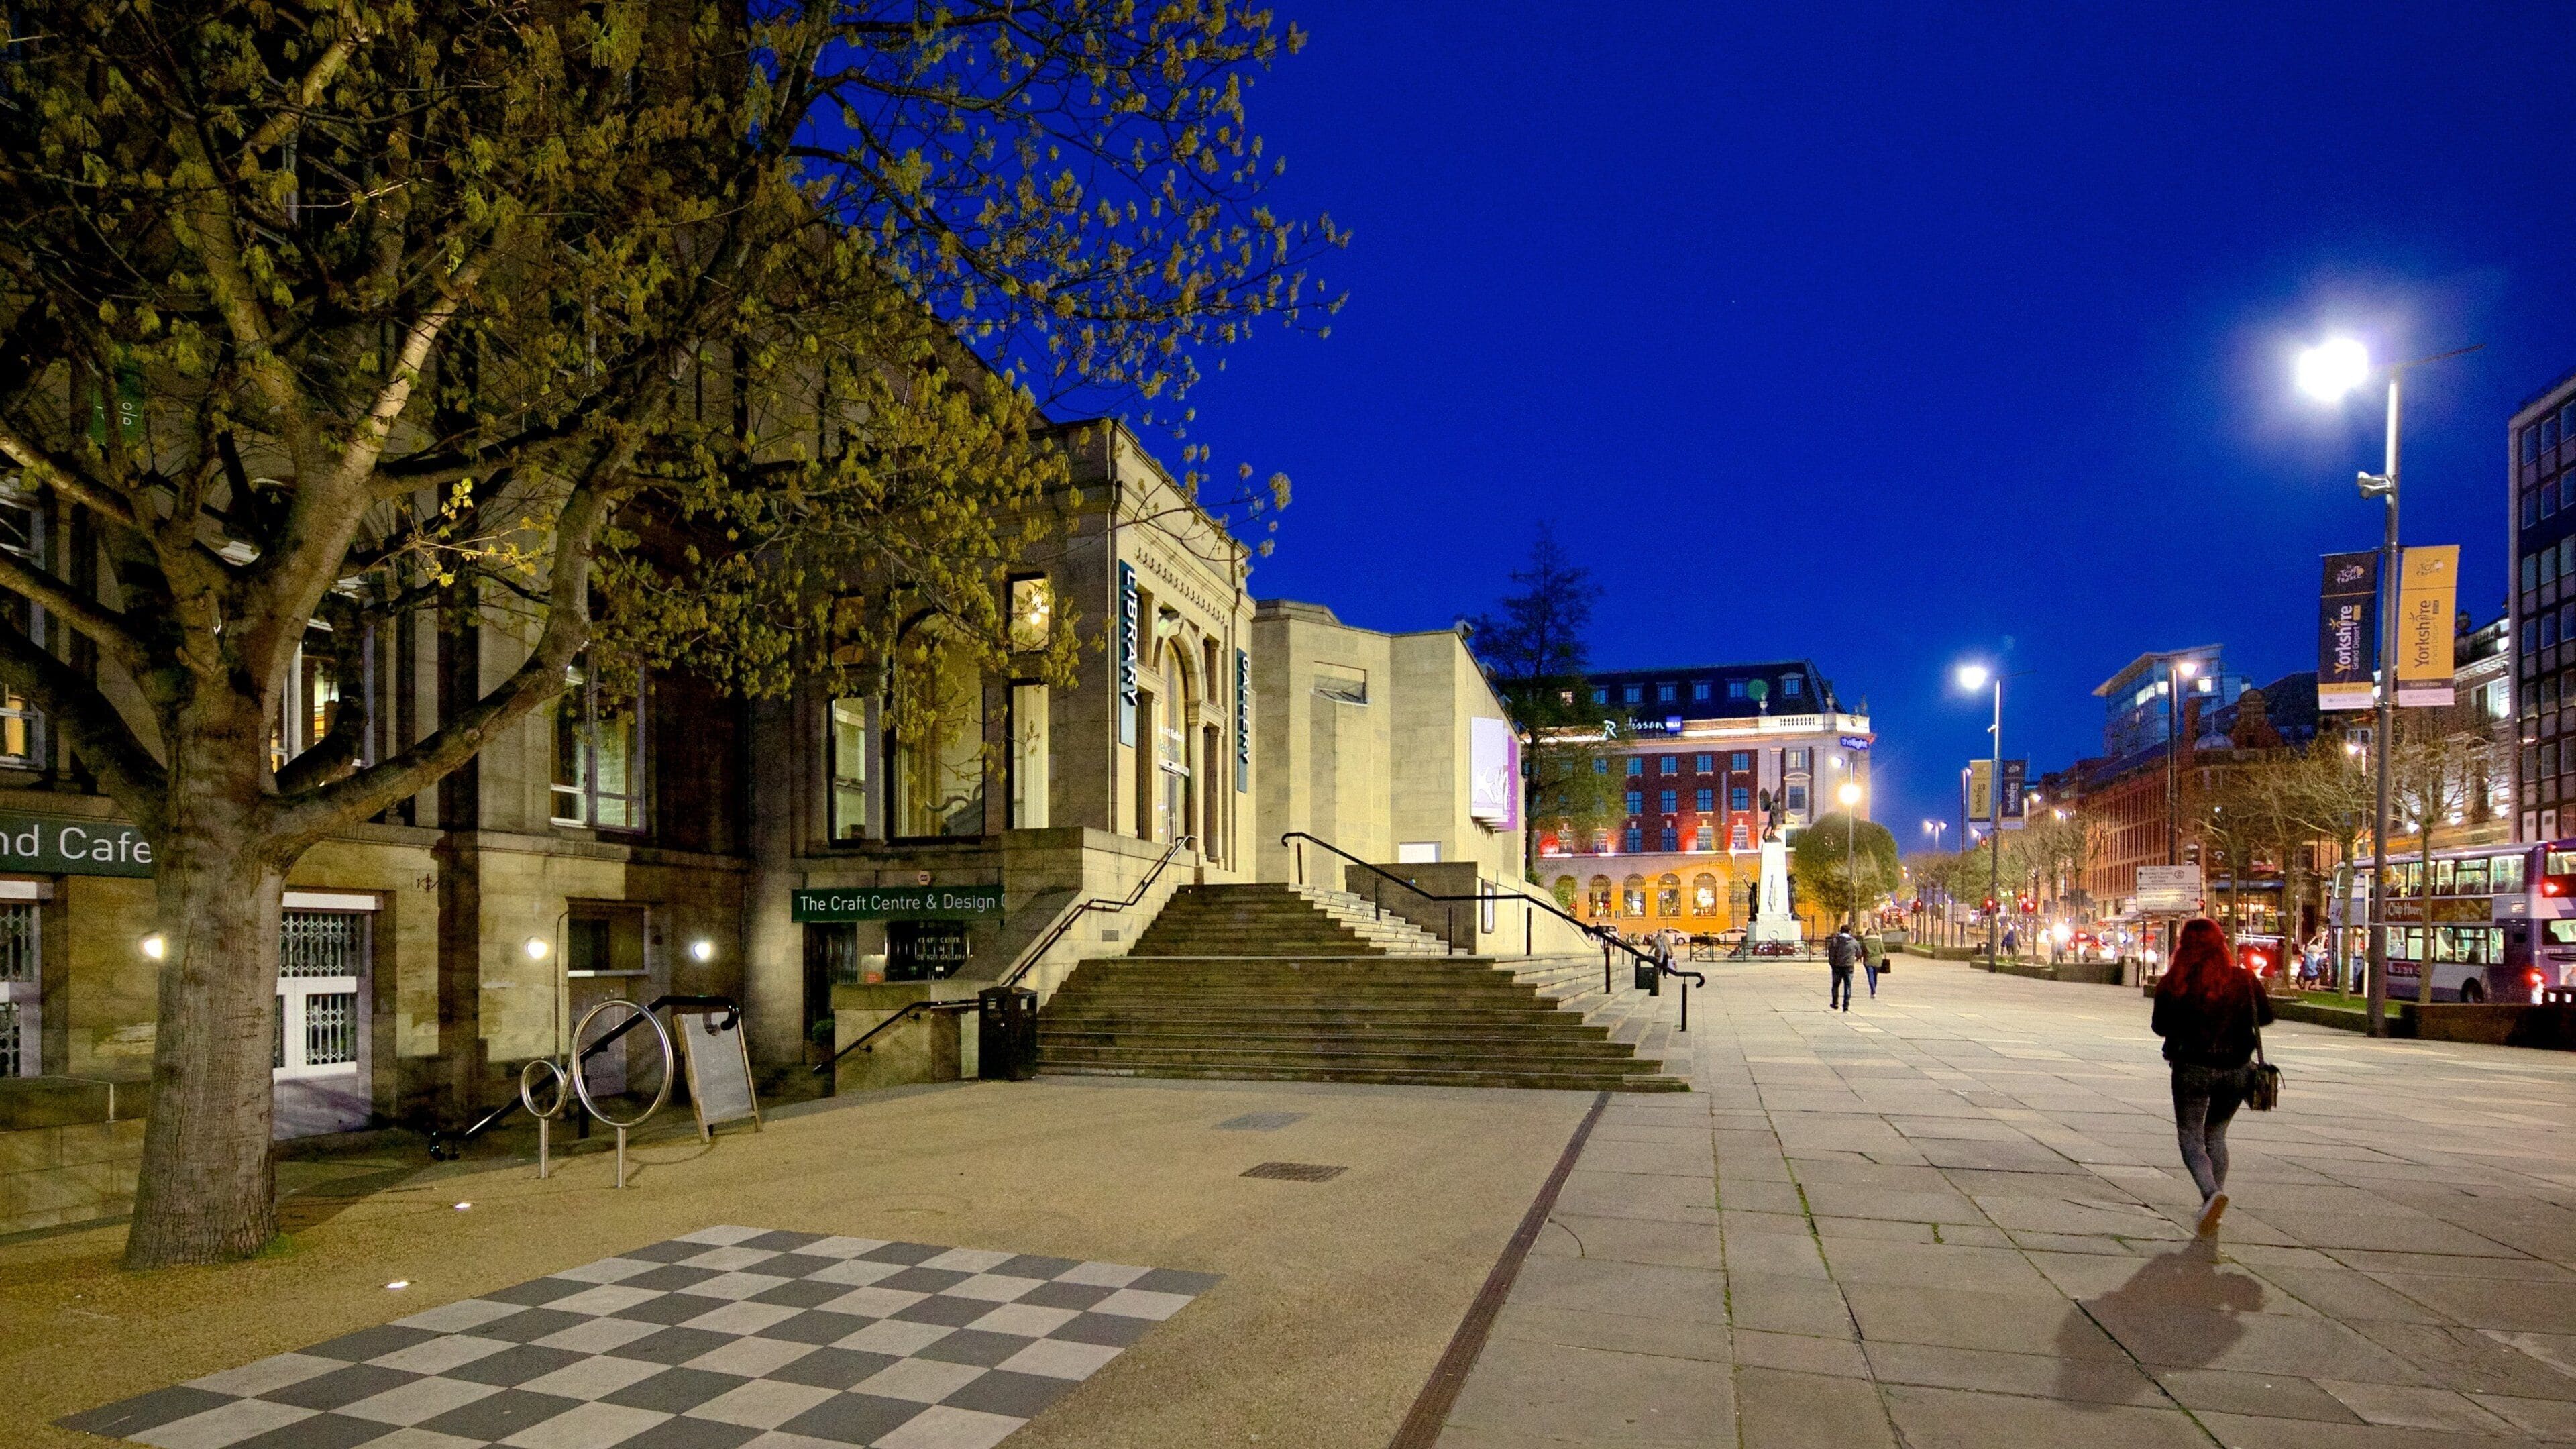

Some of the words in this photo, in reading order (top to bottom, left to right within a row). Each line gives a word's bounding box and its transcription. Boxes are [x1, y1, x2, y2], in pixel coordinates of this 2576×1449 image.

[1127, 570, 1138, 706] LIBRARY
[2334, 605, 2355, 674] Yorkshire
[2414, 600, 2433, 669] Yorkshire
[2352, 650, 2360, 670] Grand
[1602, 716, 1664, 739] Rdisson
[59, 826, 152, 863] Cafe
[800, 896, 826, 912] The
[830, 895, 866, 911] Craft
[871, 895, 920, 911] Centre
[926, 894, 937, 910] &
[943, 893, 995, 912] Design
